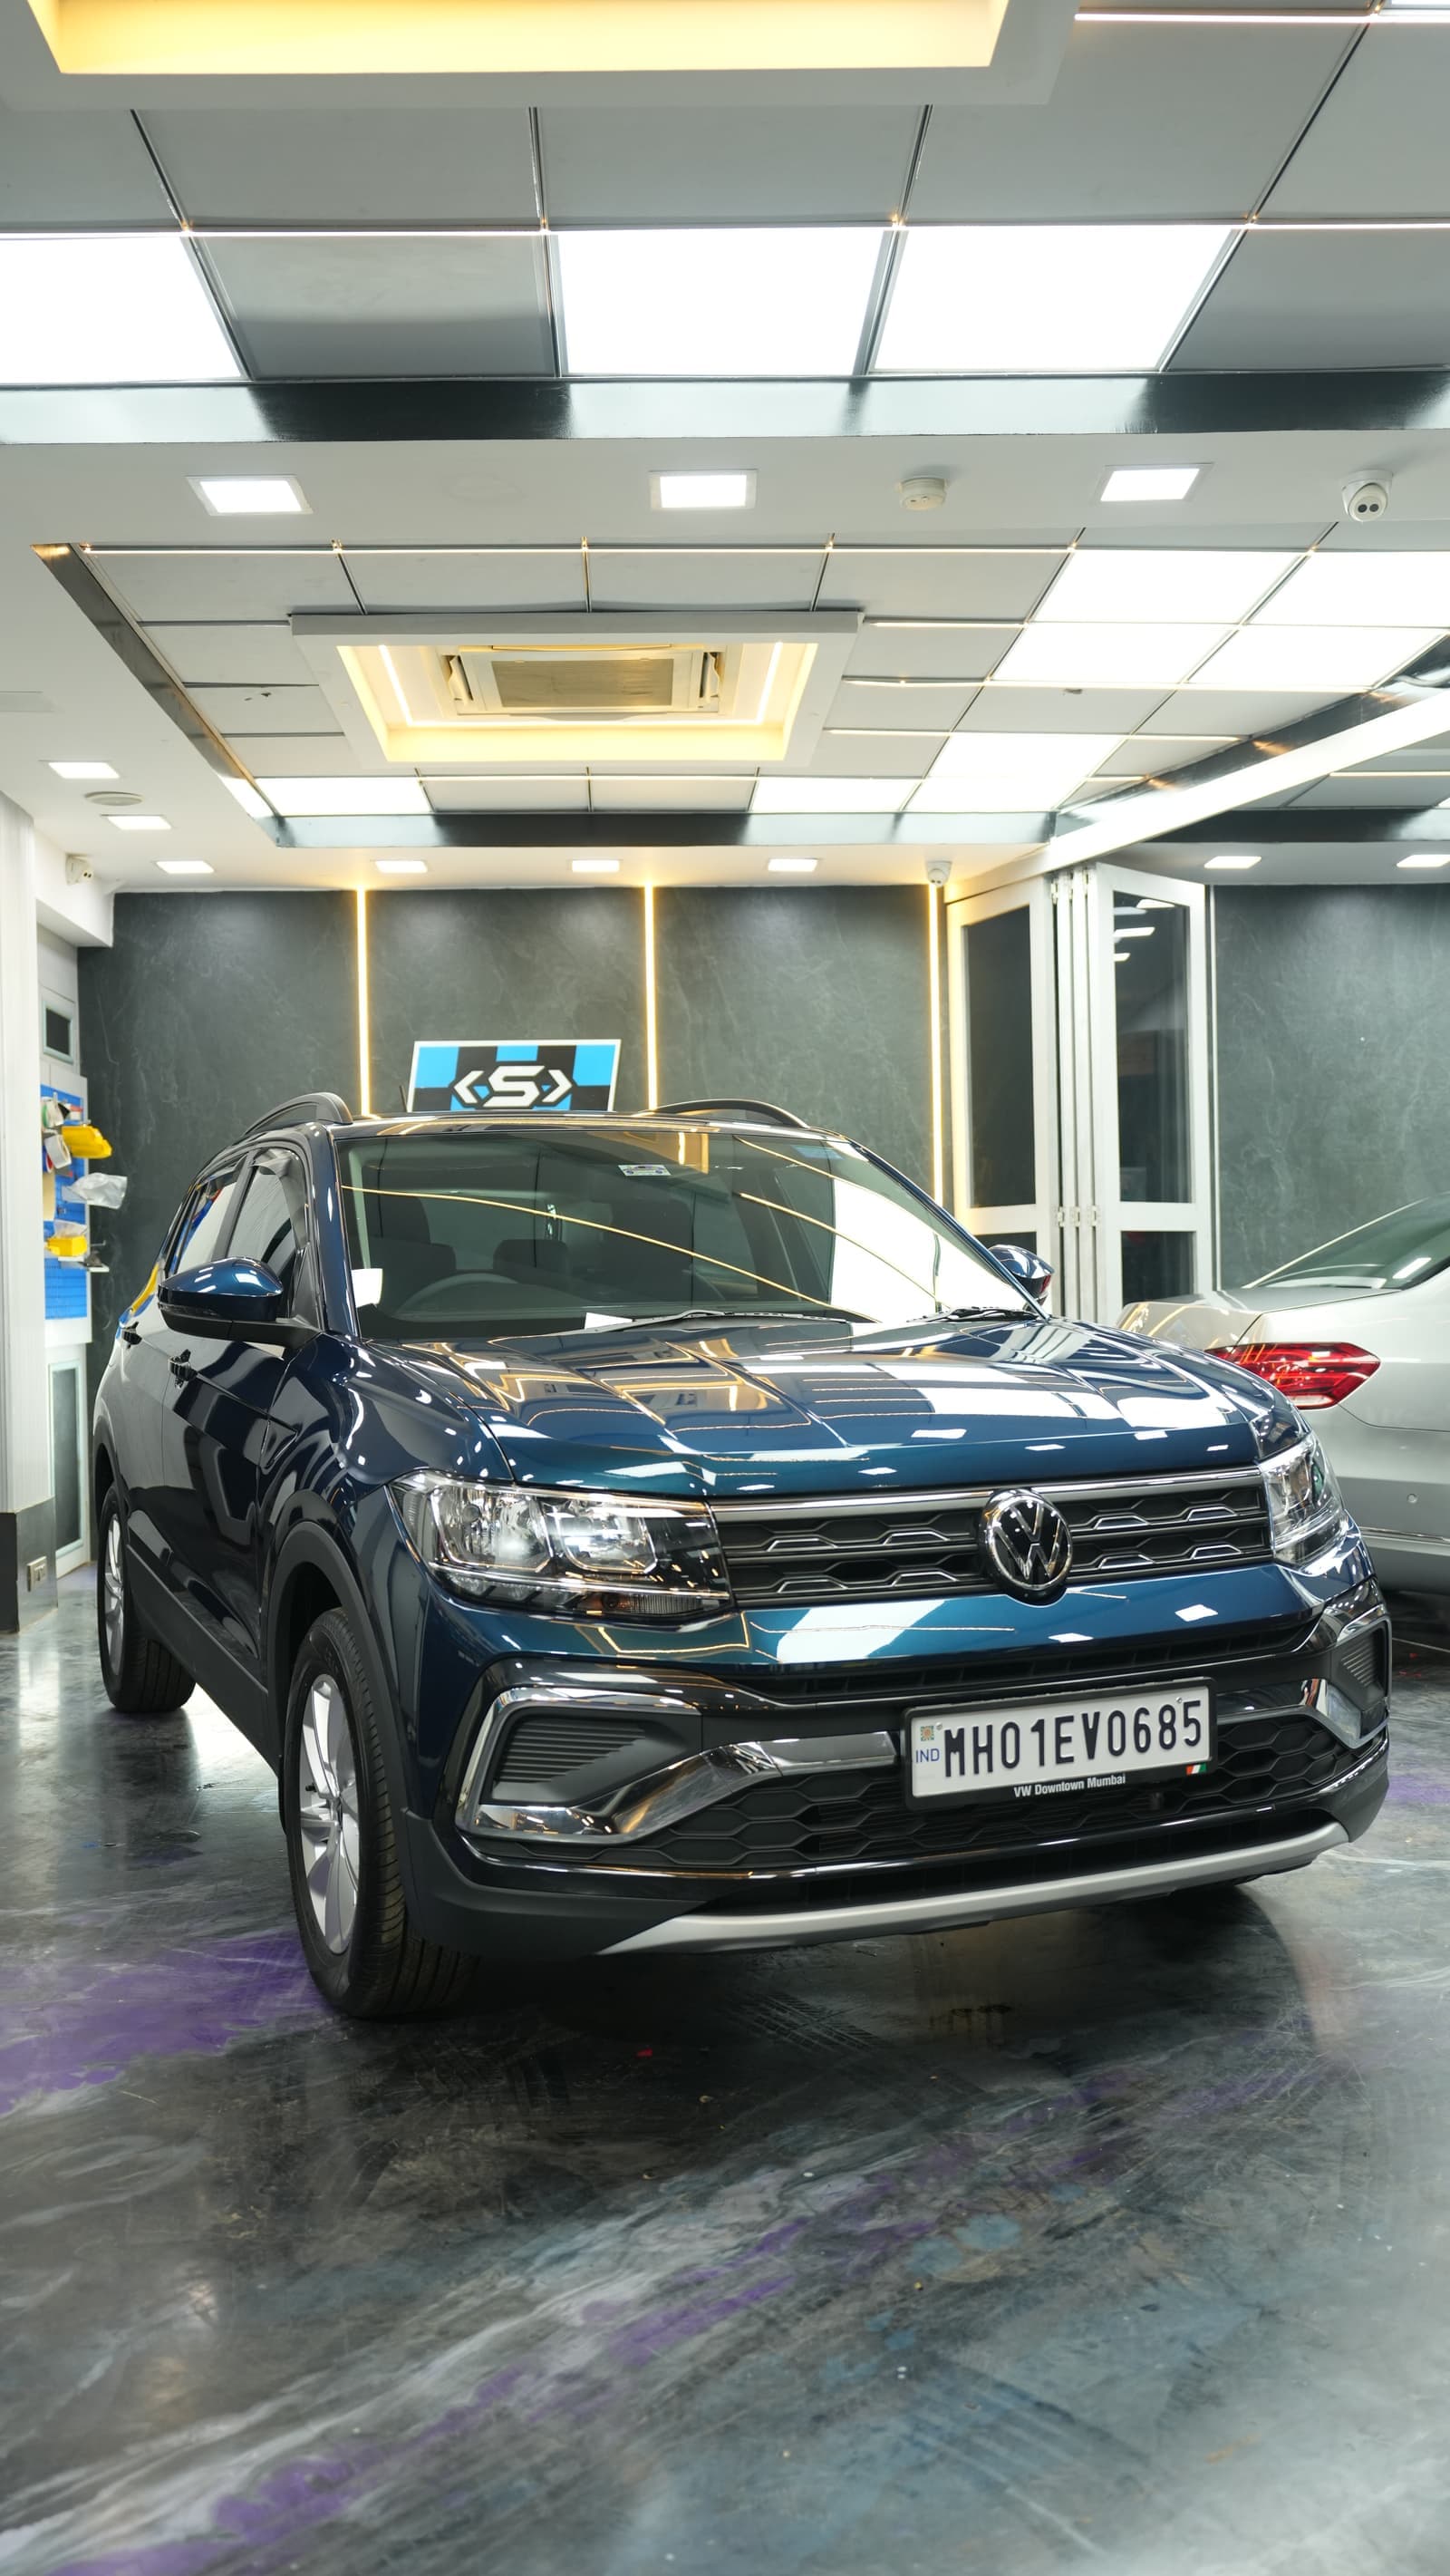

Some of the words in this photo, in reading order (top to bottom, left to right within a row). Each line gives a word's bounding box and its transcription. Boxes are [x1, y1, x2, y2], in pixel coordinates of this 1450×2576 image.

[944, 1700, 1202, 1777] MH01EV0685
[915, 1748, 941, 1763] IND
[1014, 1785, 1032, 1797] VW
[1035, 1780, 1085, 1795] Downtown
[1088, 1773, 1126, 1788] Mumbai
